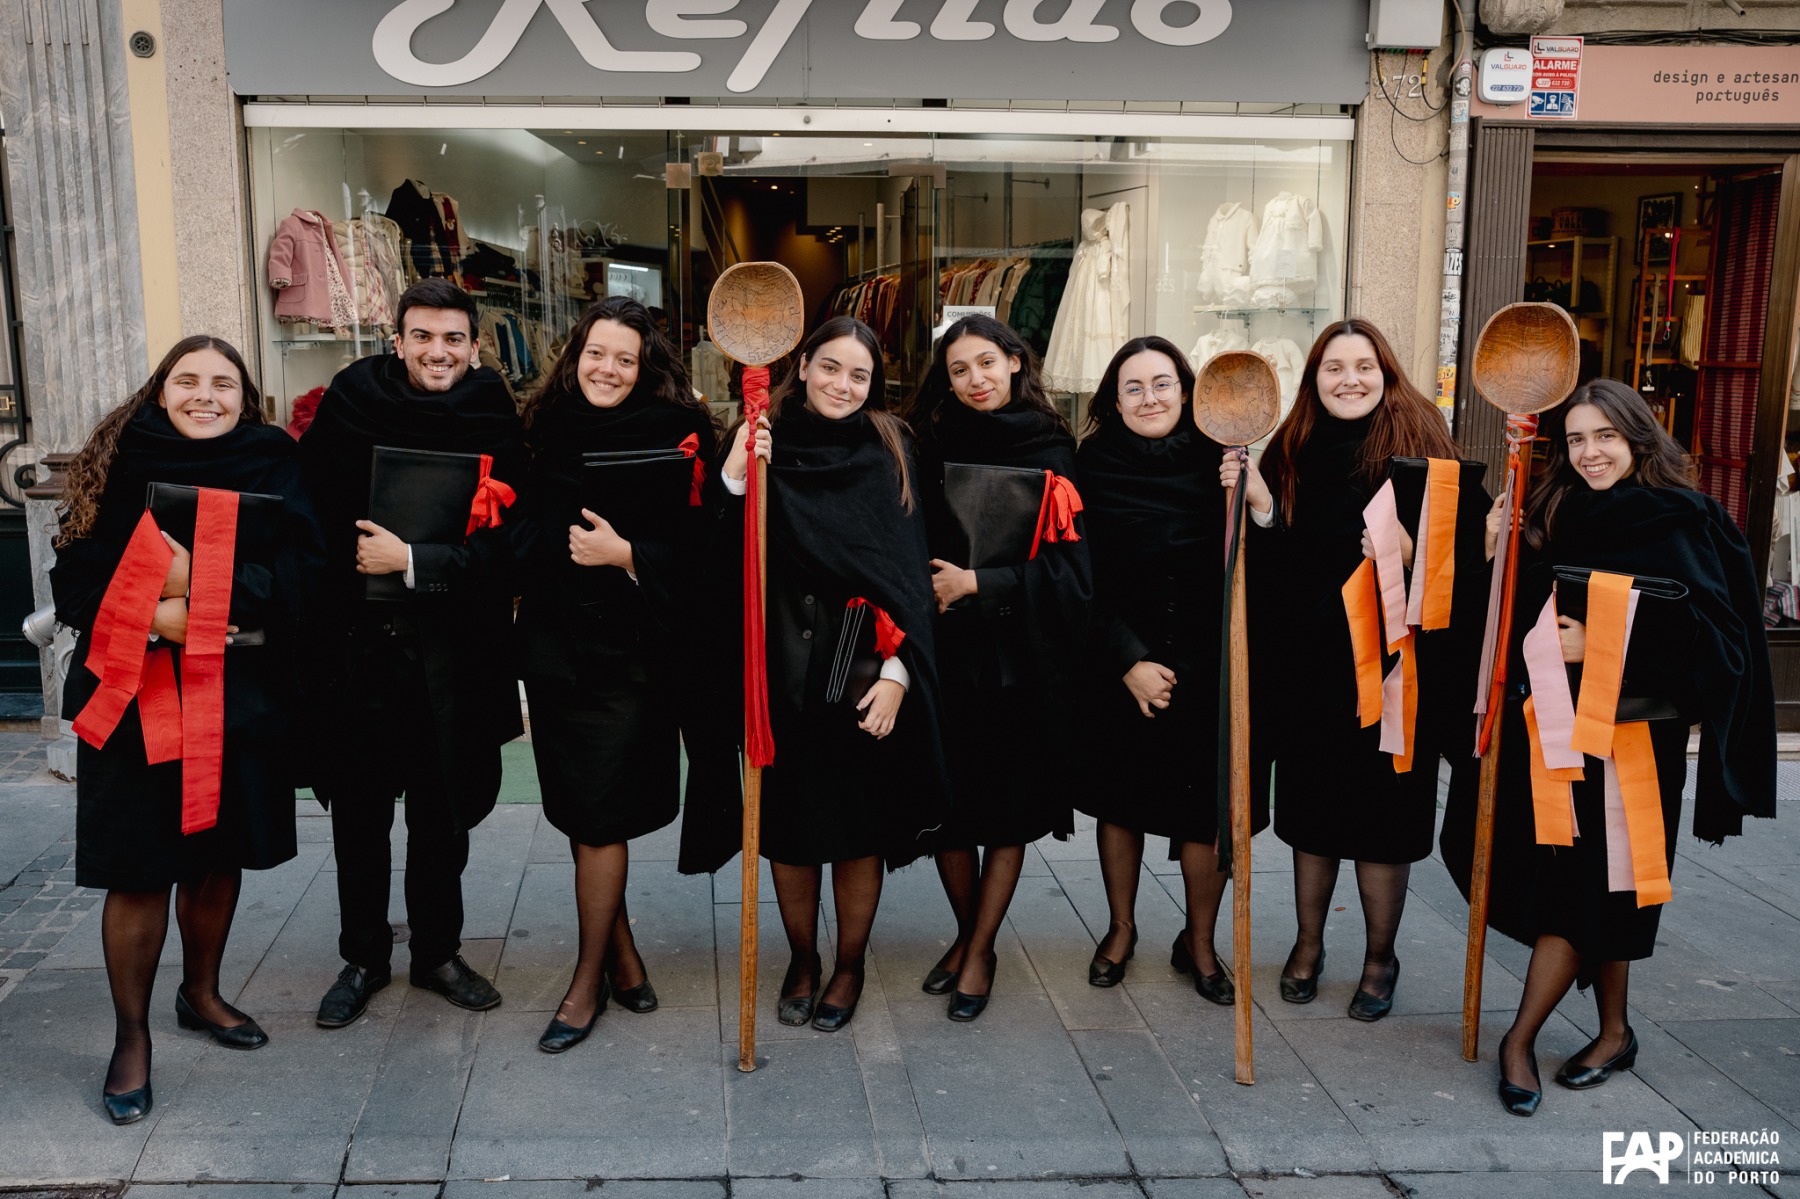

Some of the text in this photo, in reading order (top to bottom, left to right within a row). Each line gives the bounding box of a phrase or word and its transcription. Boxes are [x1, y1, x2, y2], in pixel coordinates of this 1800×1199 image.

[1533, 60, 1577, 71] ALARME
[1653, 69, 1799, 86] design e artesan
[1374, 75, 1422, 98] 272
[1695, 88, 1779, 104] português
